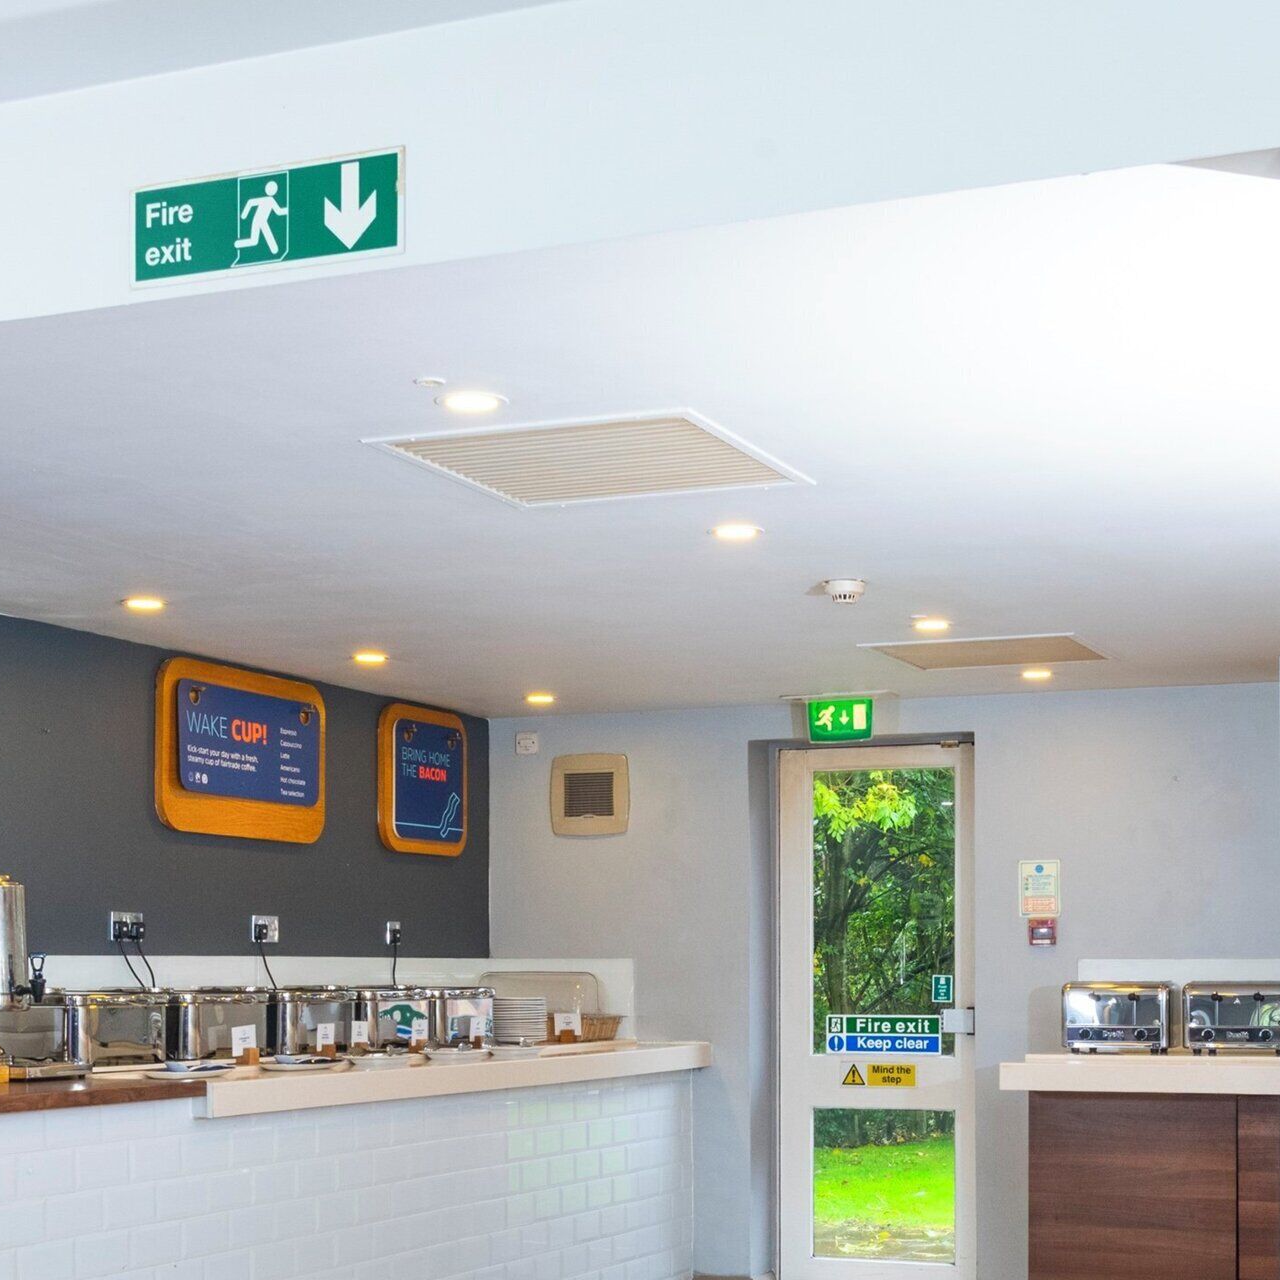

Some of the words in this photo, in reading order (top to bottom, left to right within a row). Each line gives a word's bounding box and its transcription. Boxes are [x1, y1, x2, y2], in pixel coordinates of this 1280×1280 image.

[145, 201, 194, 228] Fire
[145, 237, 192, 267] exit
[186, 710, 228, 739] WAKE
[231, 719, 268, 745] CUP!
[187, 744, 210, 756] Kick-start
[210, 749, 220, 757] your
[221, 751, 230, 759] day
[230, 752, 241, 760] with
[401, 746, 427, 763] BRING
[428, 752, 451, 768] HOME
[187, 754, 205, 764] steamy
[205, 758, 214, 767] cup
[215, 758, 221, 767] of
[402, 763, 417, 778] THE
[419, 765, 447, 782] BACON
[856, 1020, 891, 1033] Fire
[895, 1020, 930, 1033] exit
[857, 1036, 892, 1051] Keep
[895, 1037, 929, 1050] clear
[872, 1065, 895, 1074] Mind
[896, 1065, 912, 1074] the
[881, 1075, 902, 1084] step
